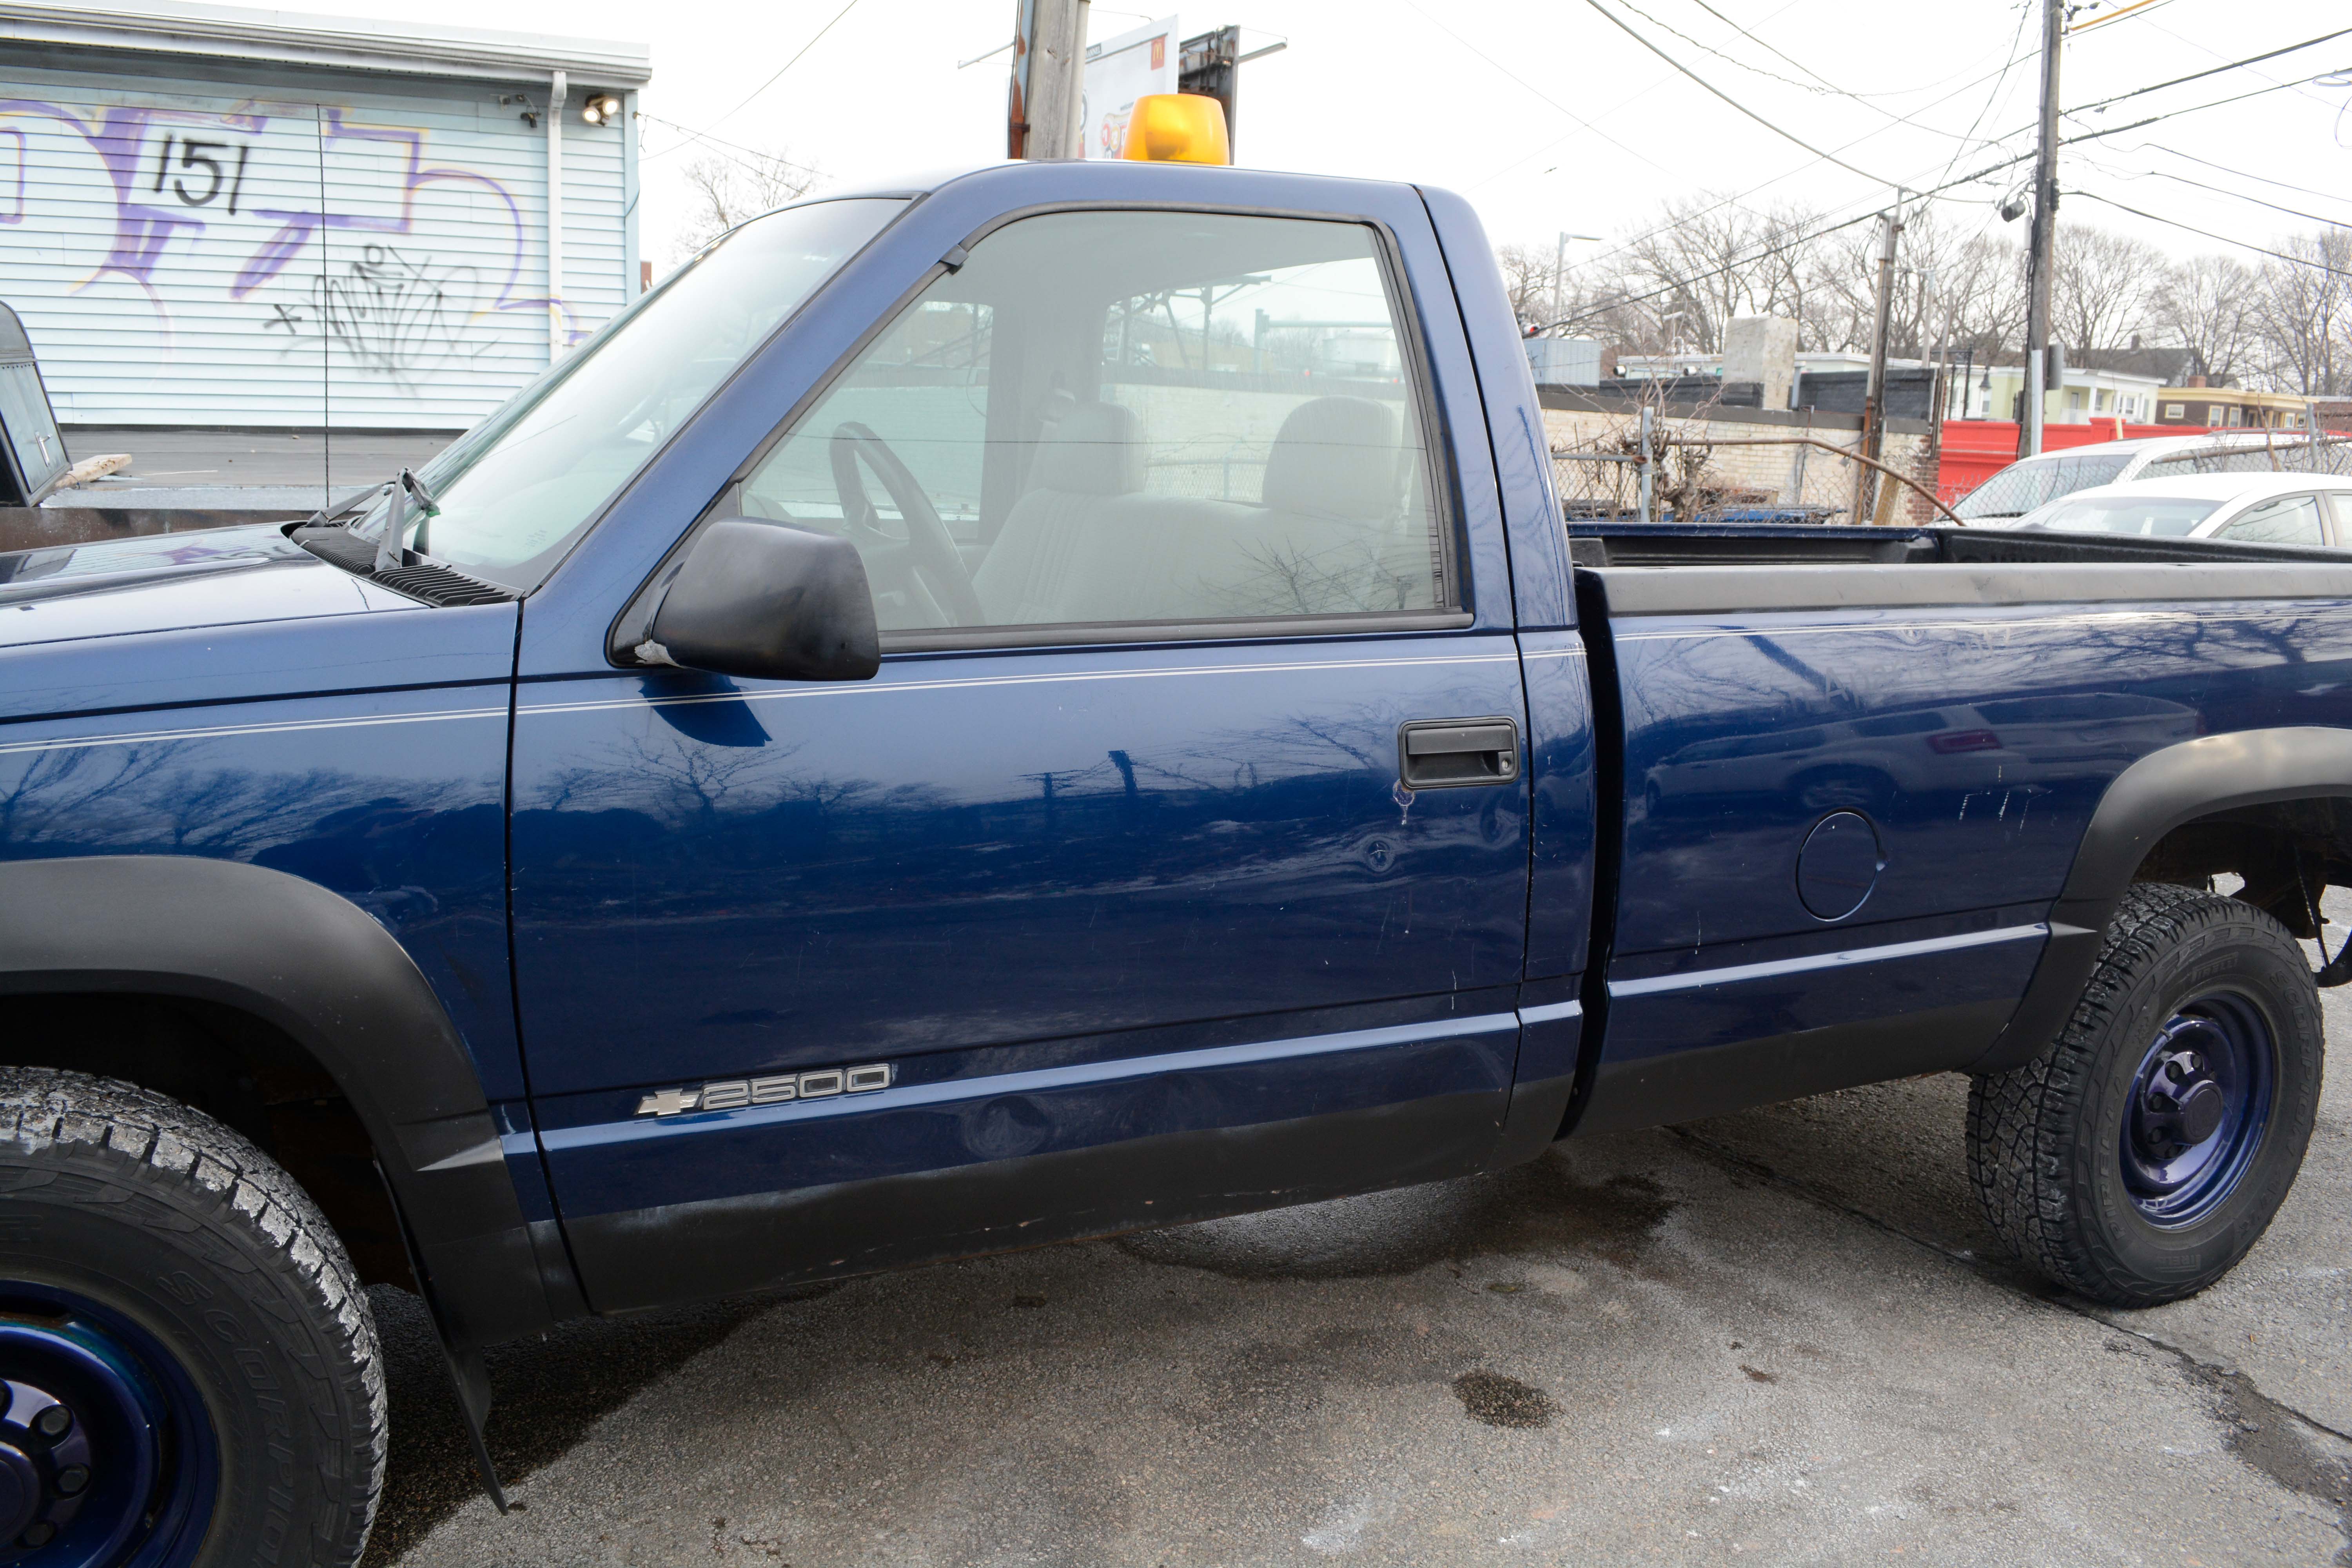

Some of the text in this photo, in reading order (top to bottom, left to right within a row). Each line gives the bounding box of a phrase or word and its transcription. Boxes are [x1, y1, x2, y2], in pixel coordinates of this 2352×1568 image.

[152, 130, 250, 216] 151
[703, 1063, 891, 1110] 2500
[2098, 1077, 2127, 1241] PIRELLI
[157, 1271, 295, 1568] SCORPIO
